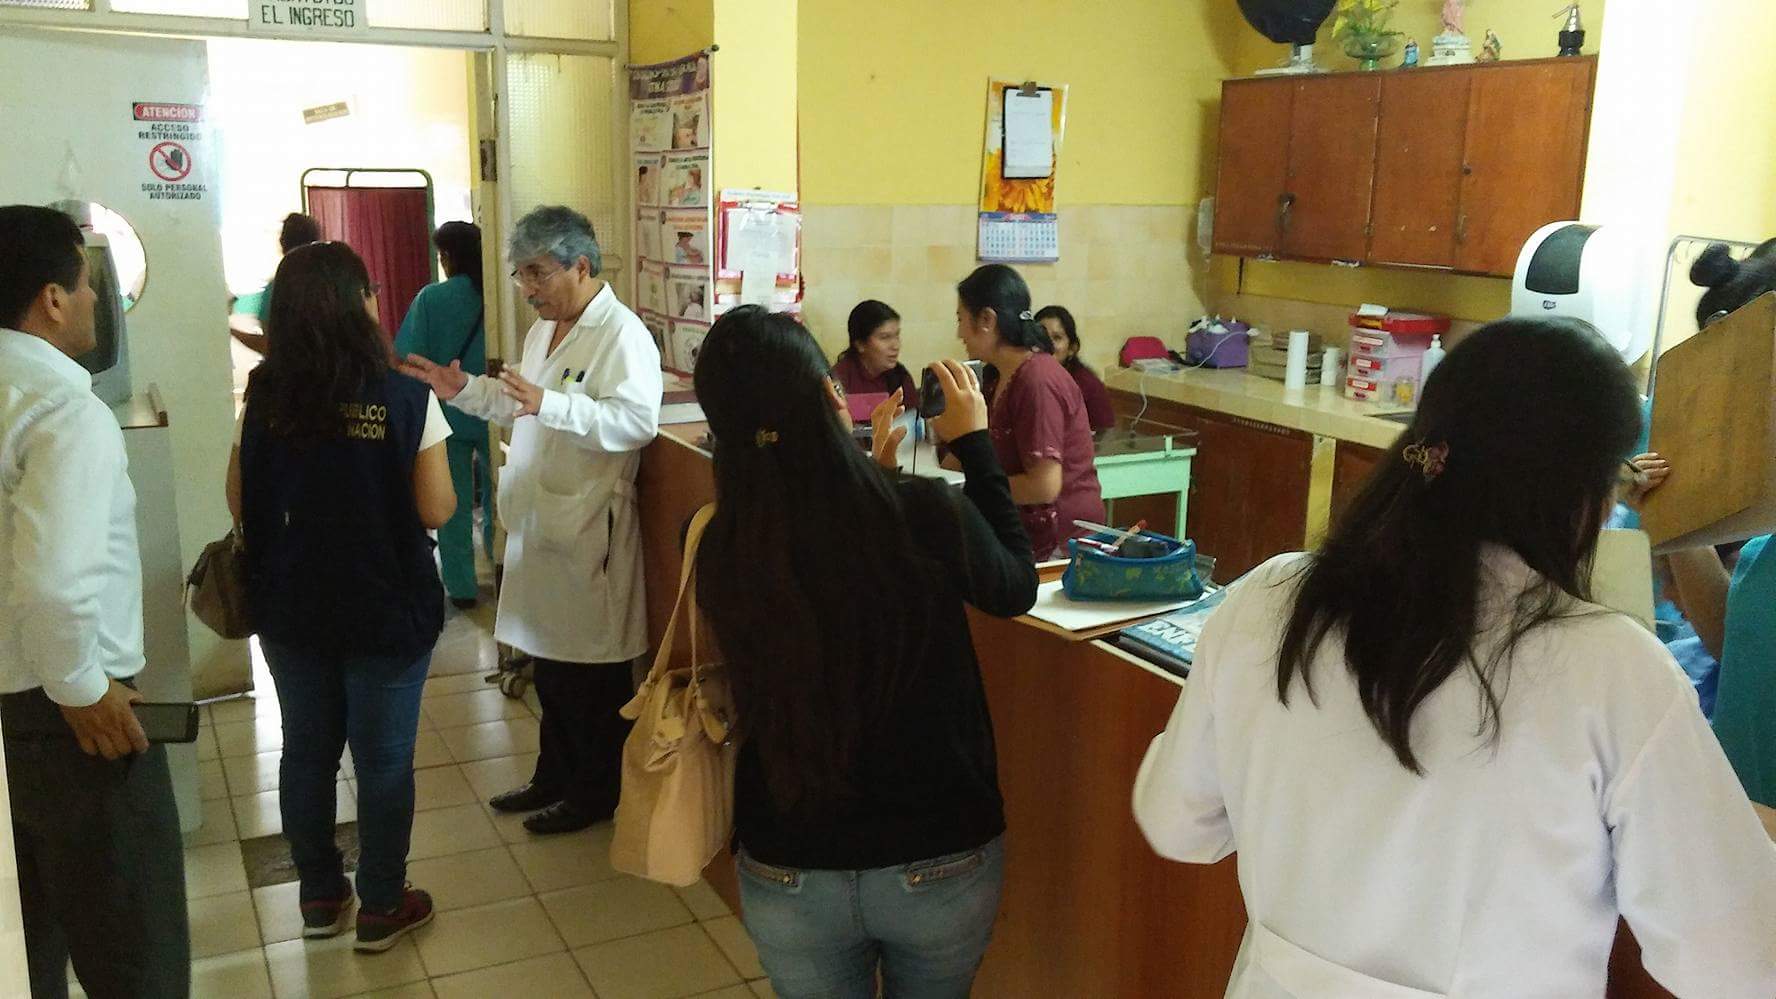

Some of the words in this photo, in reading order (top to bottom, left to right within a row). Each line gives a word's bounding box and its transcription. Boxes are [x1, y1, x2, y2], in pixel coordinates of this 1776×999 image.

[261, 4, 284, 24] EL
[288, 6, 355, 28] INGRESO
[151, 123, 190, 132] ACCESO
[138, 131, 203, 141] RESTRINGIDO
[141, 183, 163, 192] SOLO
[165, 183, 208, 193] PERSONAL
[149, 192, 202, 201] AUTORIZADO
